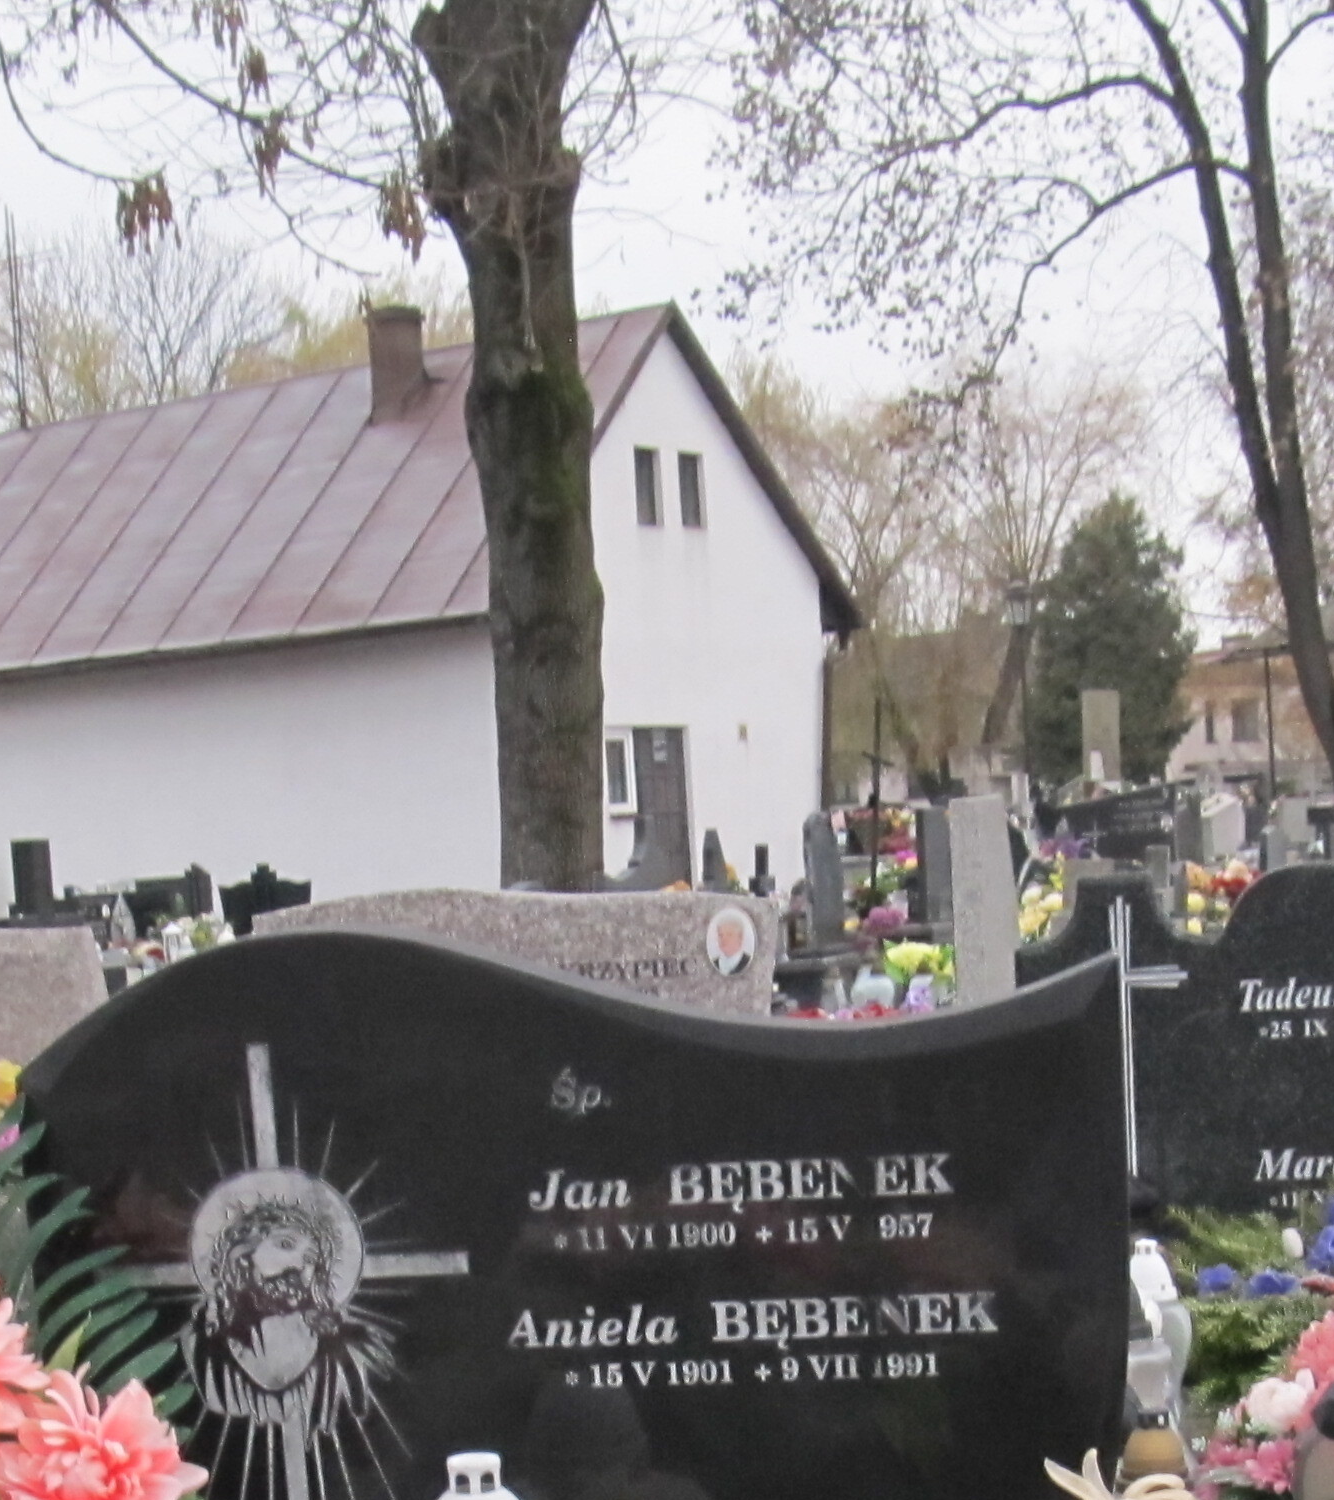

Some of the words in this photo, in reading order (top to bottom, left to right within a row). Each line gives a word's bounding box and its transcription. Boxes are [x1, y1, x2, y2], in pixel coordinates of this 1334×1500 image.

[1303, 1018, 1328, 1037] IX
[528, 1169, 631, 1211] Jan
[669, 1222, 736, 1247] 1900
[786, 1218, 819, 1243] 15
[826, 1215, 852, 1241] V
[878, 1213, 934, 1240] 957
[508, 1304, 677, 1348] Aniela
[590, 1364, 623, 1389] 15
[631, 1361, 656, 1387] V
[667, 1360, 733, 1385] 1901
[781, 1357, 799, 1381] 9
[808, 1354, 860, 1381] VII
[872, 1352, 940, 1379] 1991
